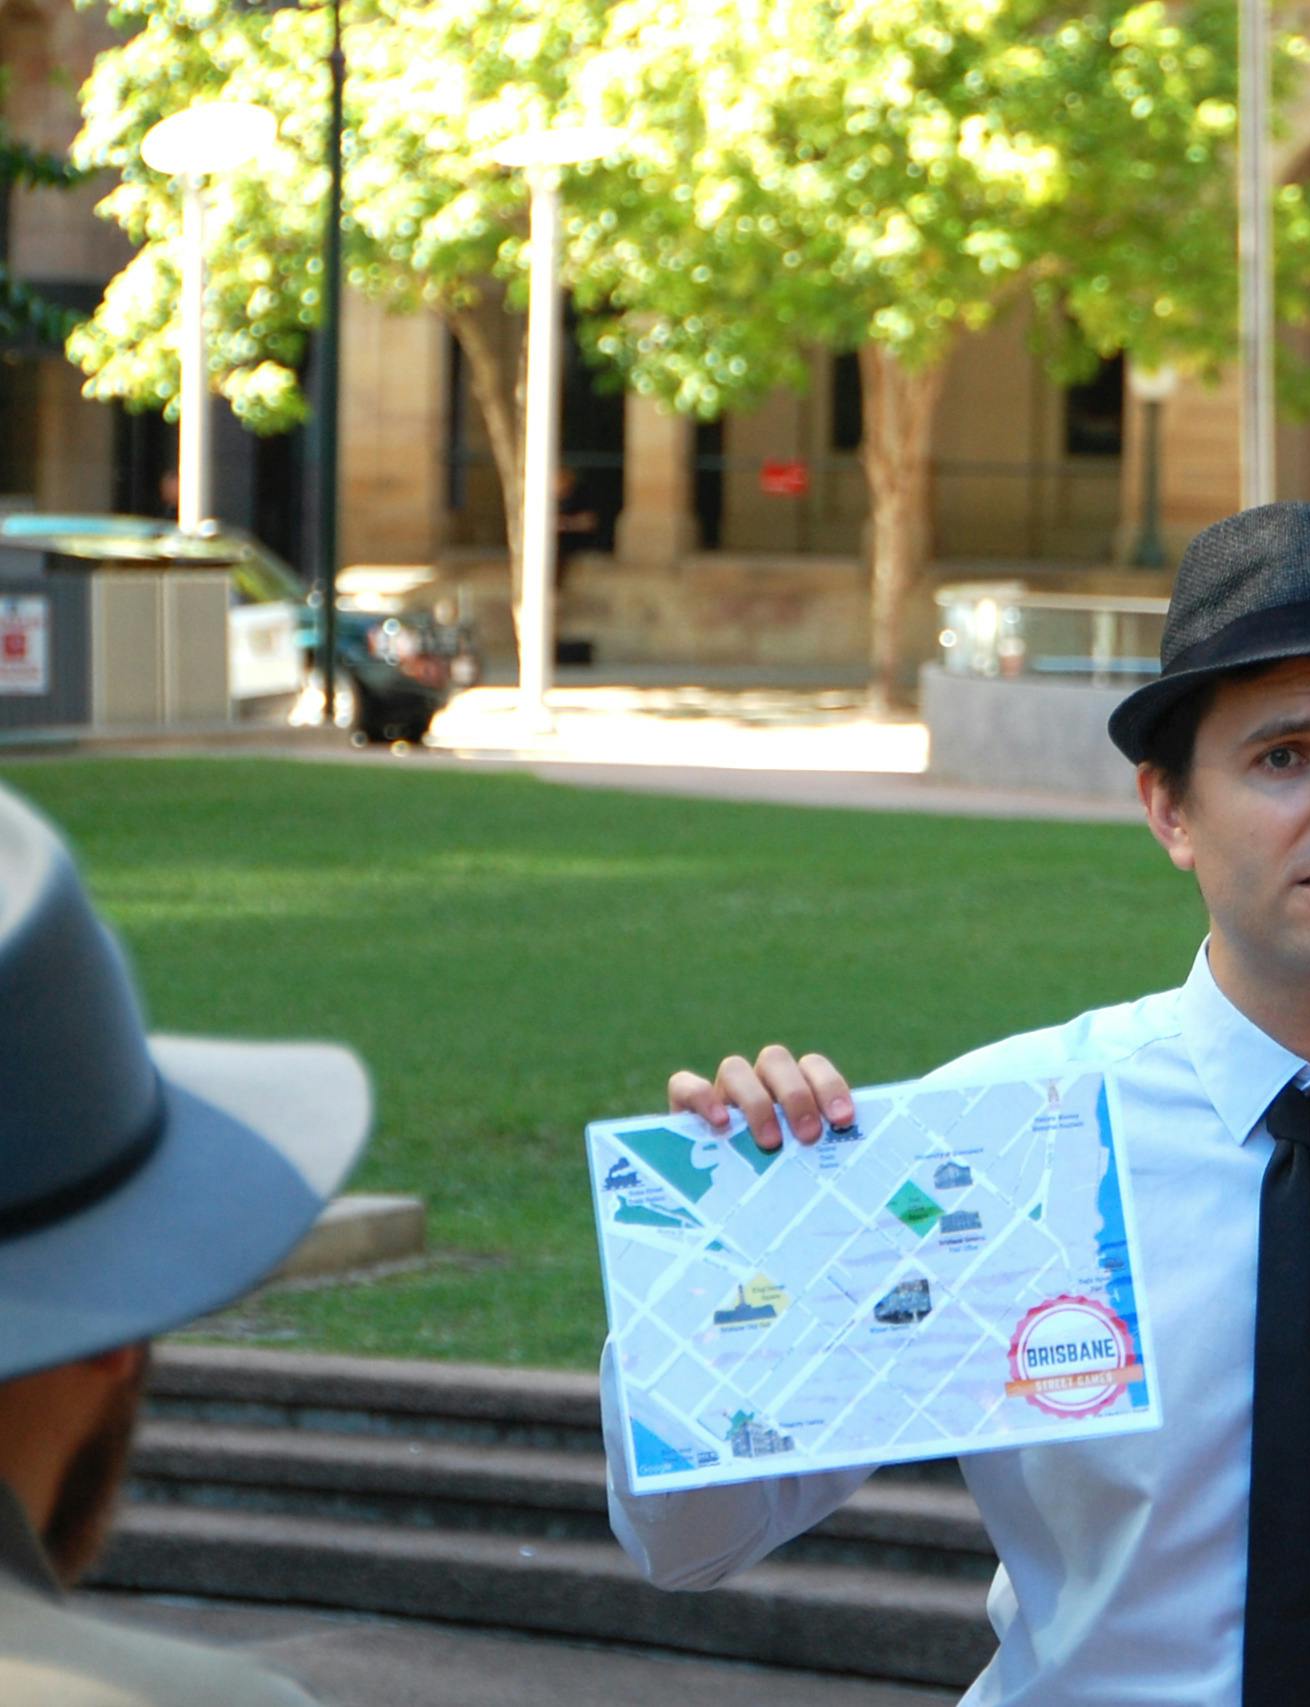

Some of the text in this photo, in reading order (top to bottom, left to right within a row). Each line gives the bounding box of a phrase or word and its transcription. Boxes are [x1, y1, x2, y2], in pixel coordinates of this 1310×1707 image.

[1027, 1339, 1116, 1368] BRISBANE
[1035, 1375, 1074, 1392] STREET
[639, 1462, 672, 1475] Google
